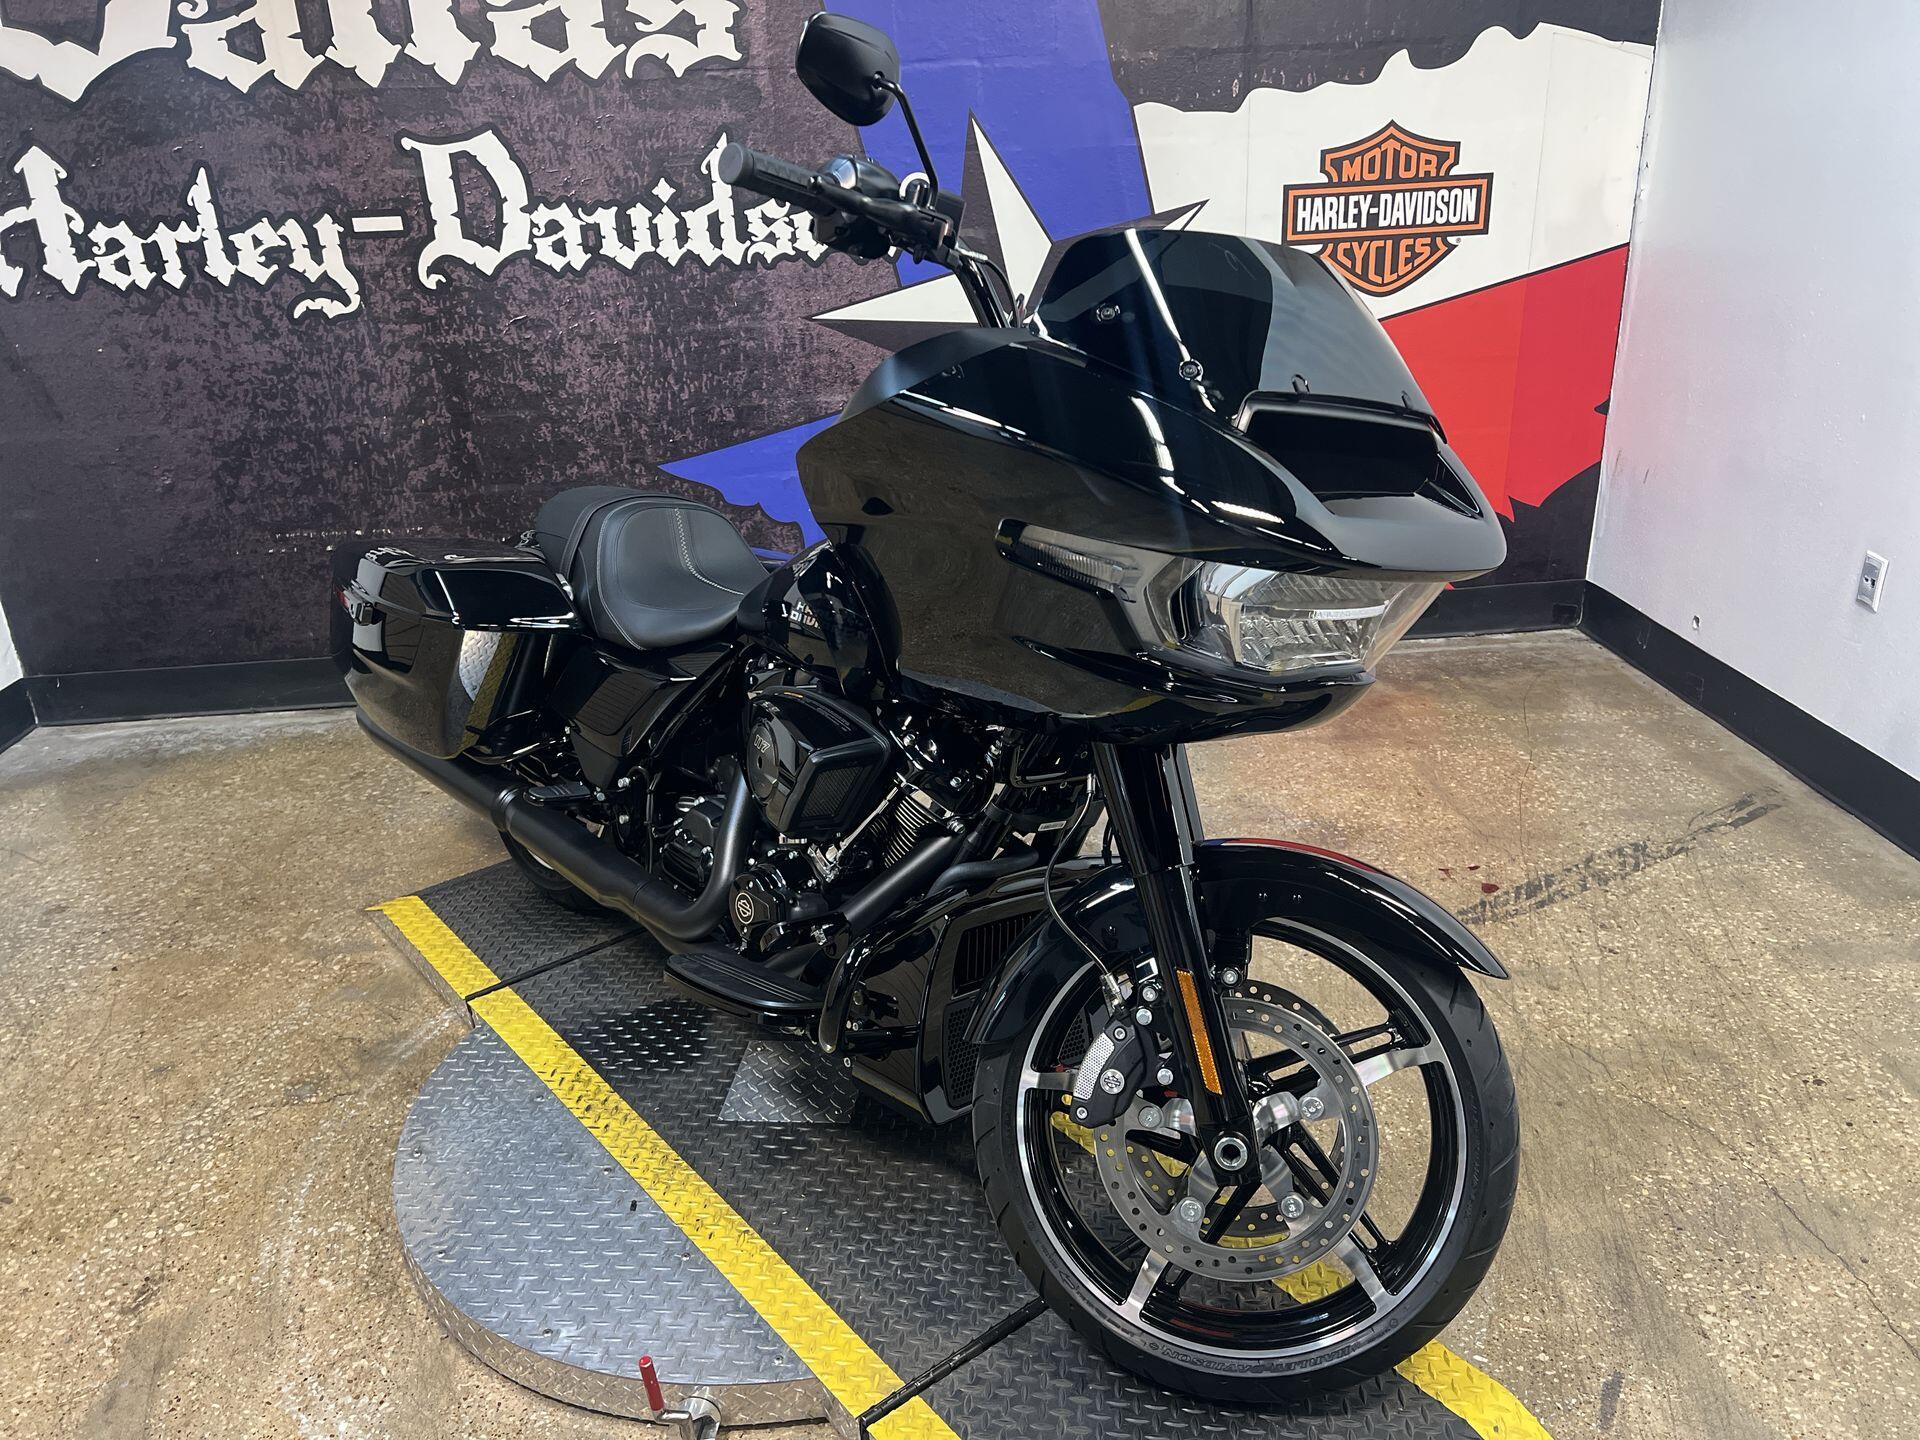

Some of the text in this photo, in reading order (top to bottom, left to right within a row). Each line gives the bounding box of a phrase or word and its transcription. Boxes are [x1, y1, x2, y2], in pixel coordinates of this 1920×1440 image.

[1342, 138, 1437, 182] MOTOR
[0, 129, 897, 319] Harley-Davids
[1296, 188, 1477, 232] HARLEY-DAVIDSON
[1337, 237, 1431, 285] CYCLES
